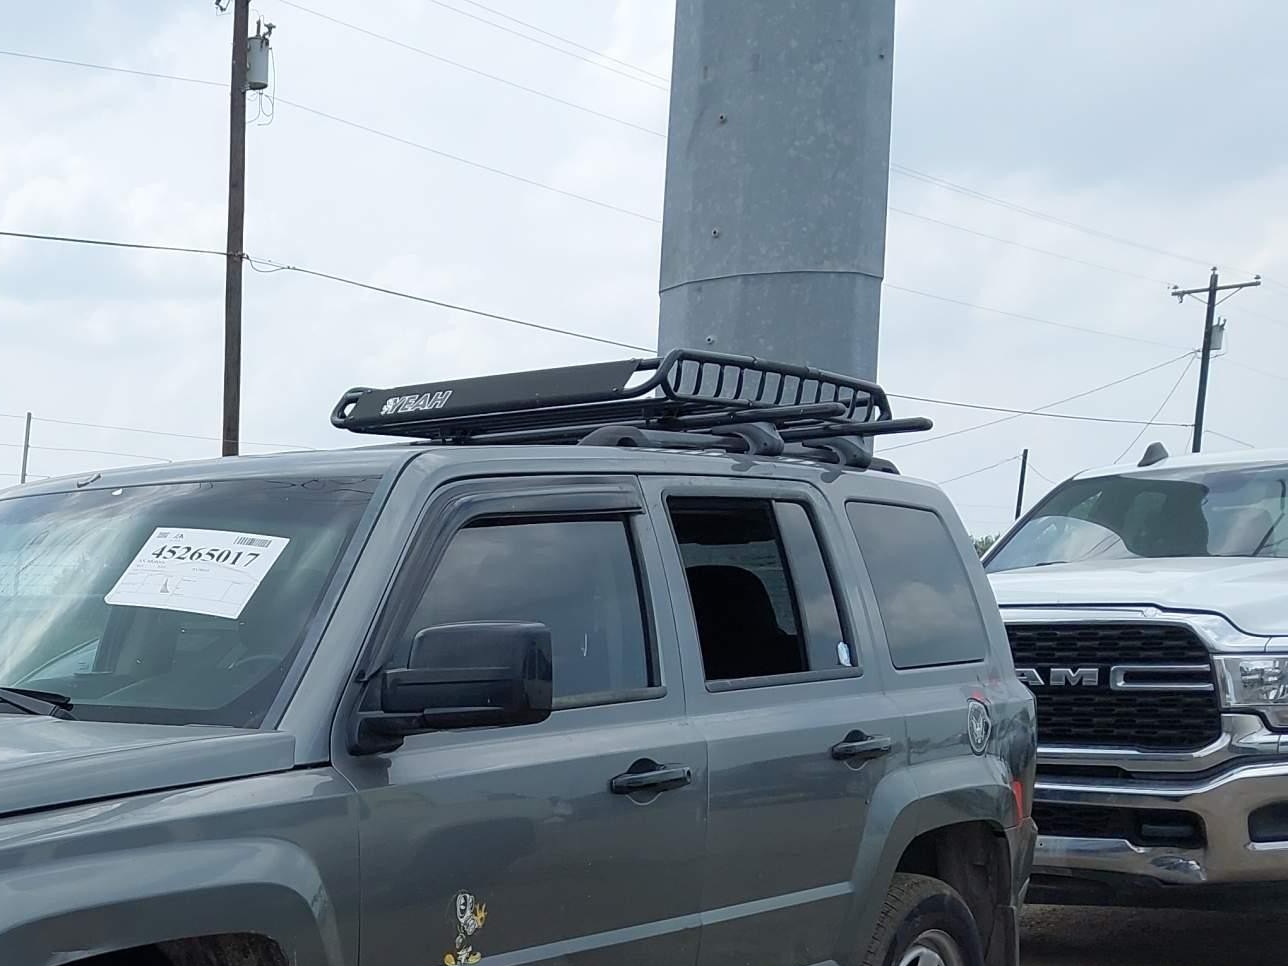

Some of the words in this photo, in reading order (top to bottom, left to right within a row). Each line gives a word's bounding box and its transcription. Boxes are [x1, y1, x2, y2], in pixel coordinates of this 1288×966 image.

[383, 390, 453, 415] YEAH
[152, 545, 260, 568] 45265017
[1015, 668, 1099, 686] AM
